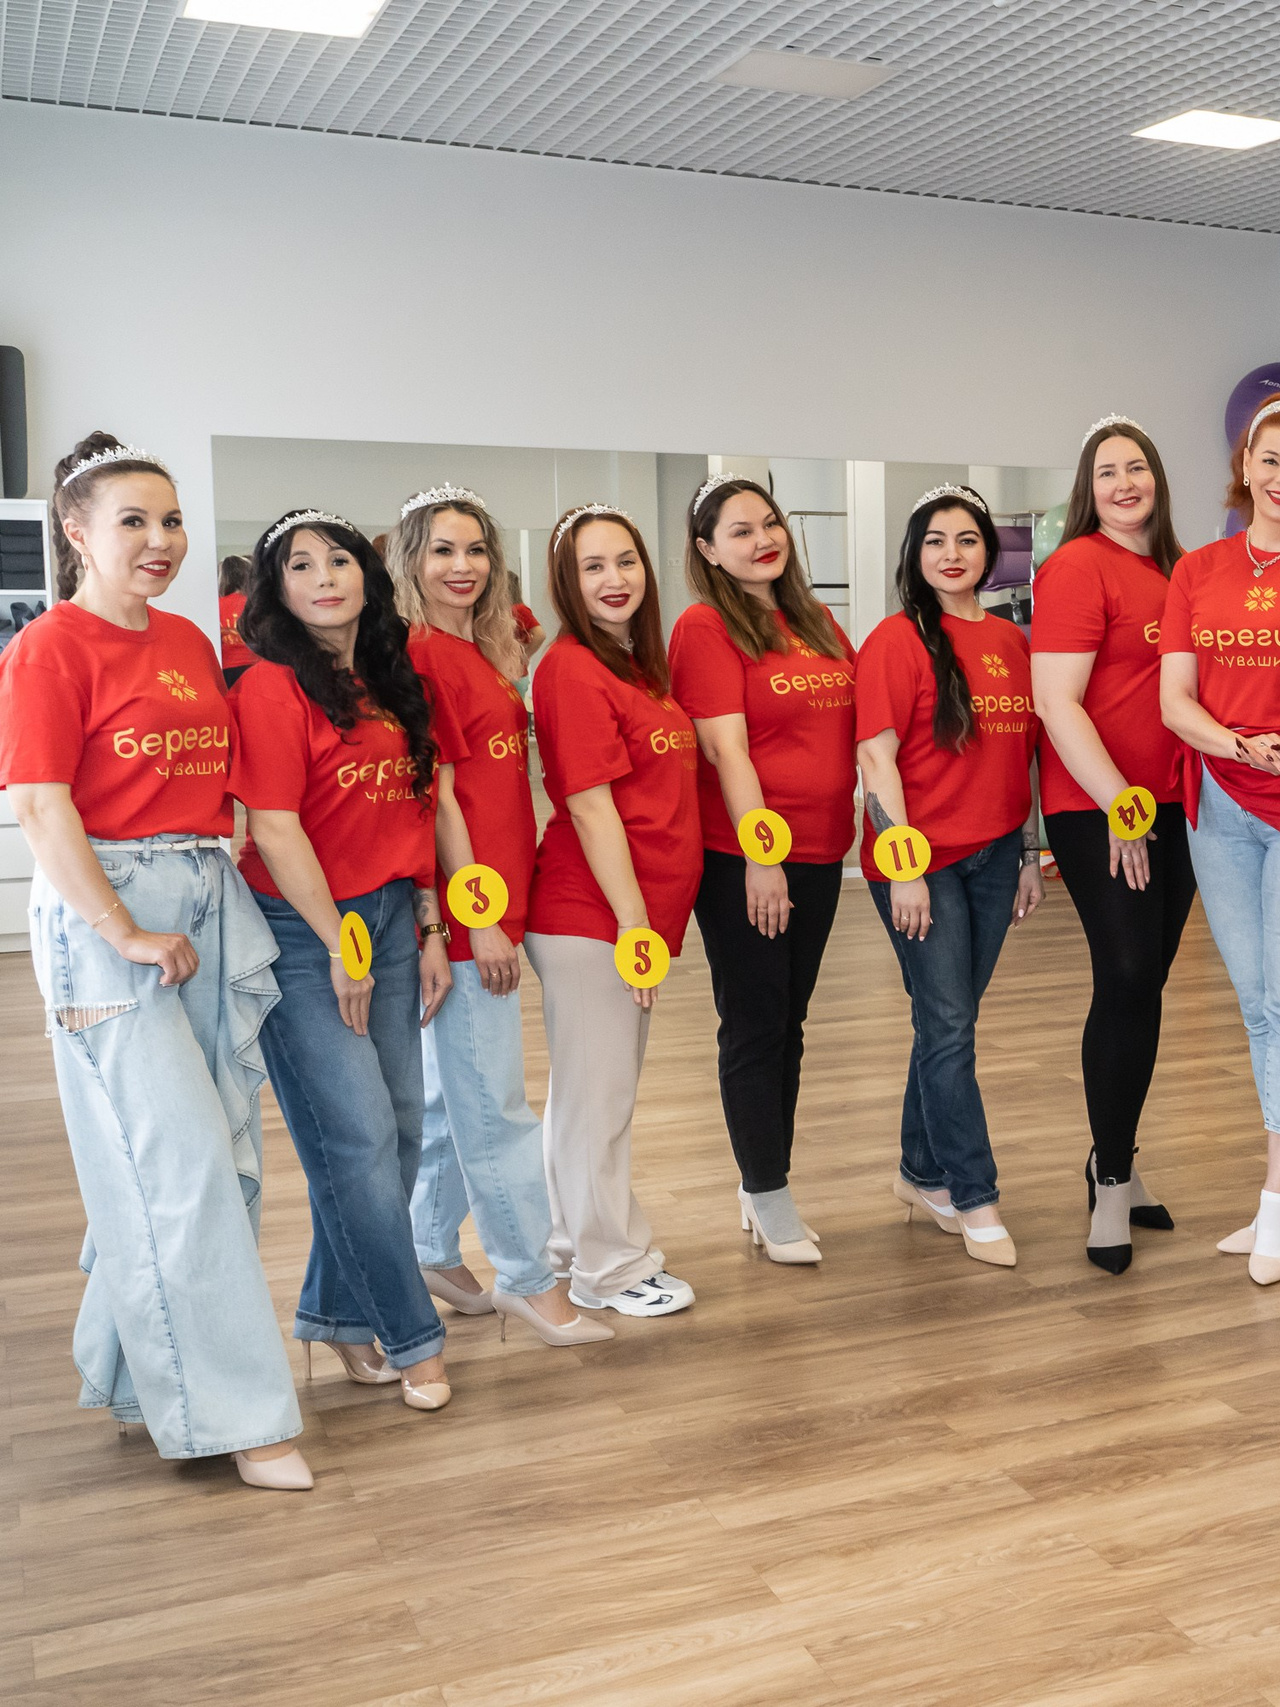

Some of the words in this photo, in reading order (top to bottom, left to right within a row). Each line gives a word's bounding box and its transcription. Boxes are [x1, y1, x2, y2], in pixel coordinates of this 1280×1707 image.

[1116, 793, 1150, 832] 14
[754, 820, 775, 854] 9
[888, 837, 918, 872] 11
[464, 876, 490, 915] 3
[348, 927, 364, 965] 1
[633, 940, 652, 976] 5
